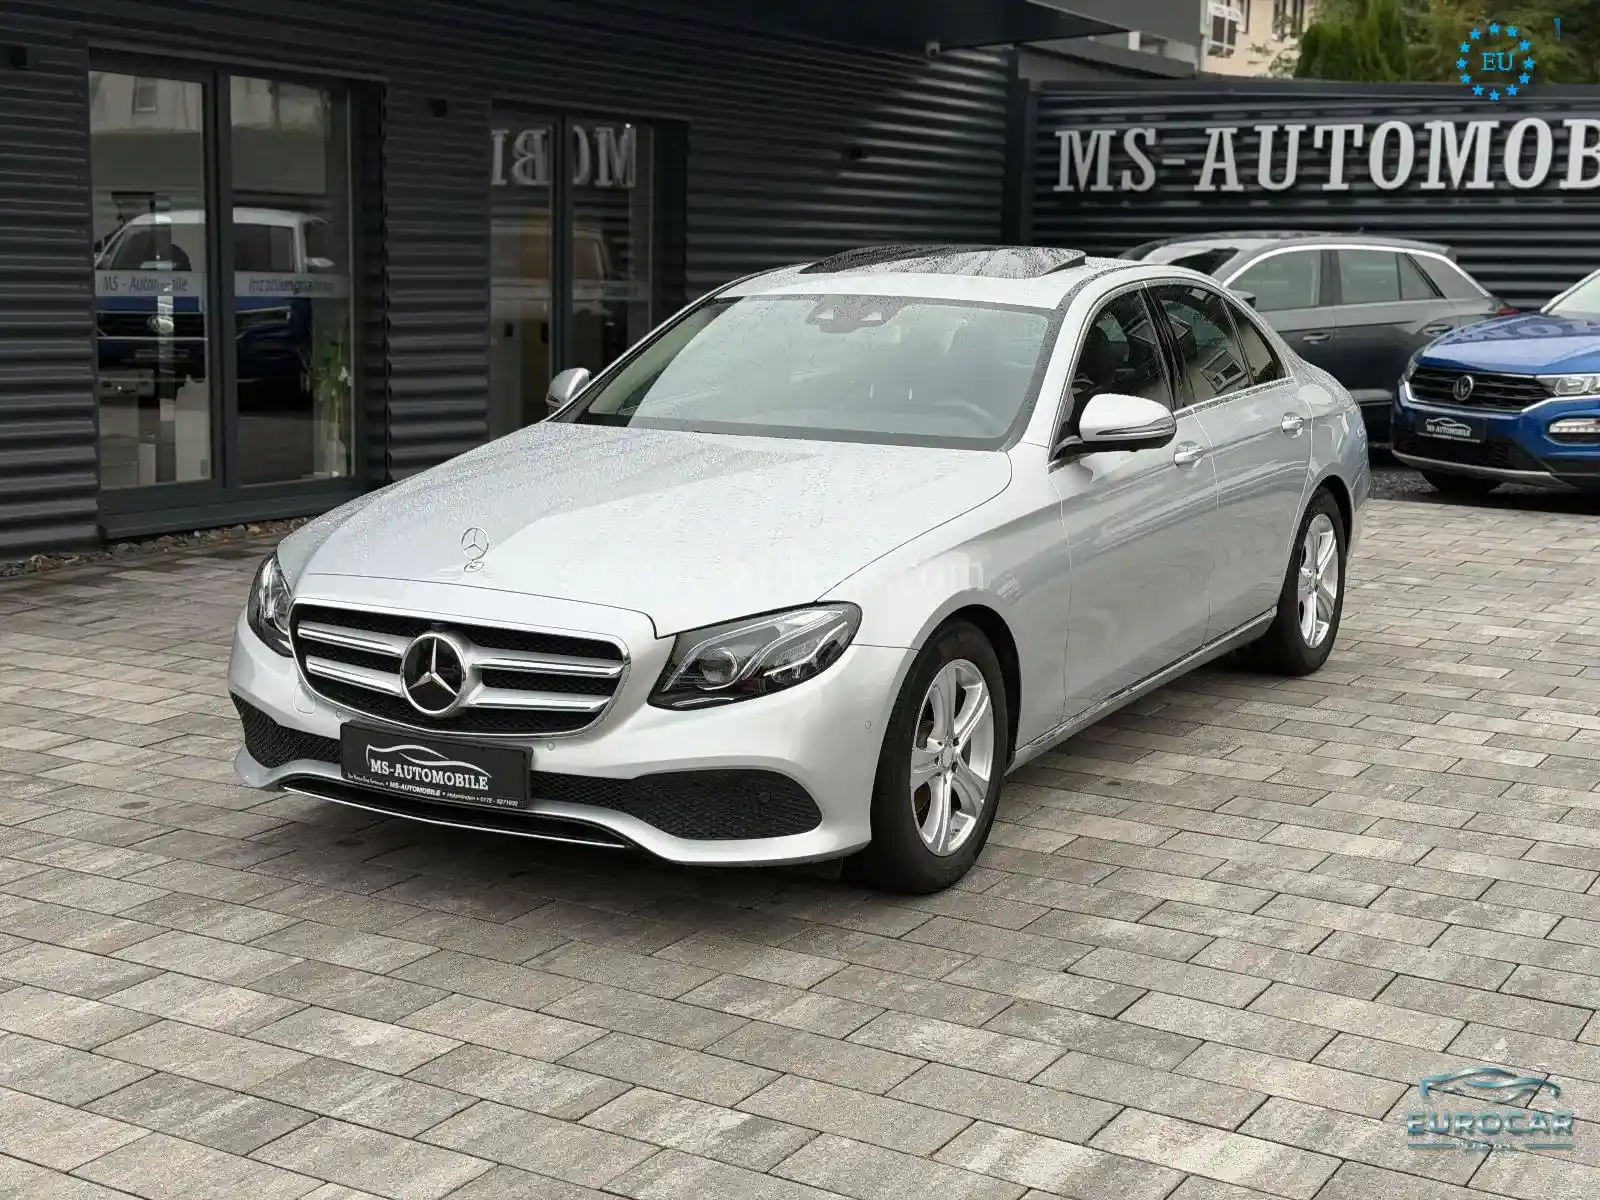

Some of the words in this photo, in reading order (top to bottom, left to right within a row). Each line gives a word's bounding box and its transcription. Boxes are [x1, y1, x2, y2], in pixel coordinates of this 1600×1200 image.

[1053, 117, 1600, 193] MS-AUTOMOB
[370, 758, 488, 791] MS-AUTOMOBILE
[389, 781, 441, 797] MS-AUTOMOBILE
